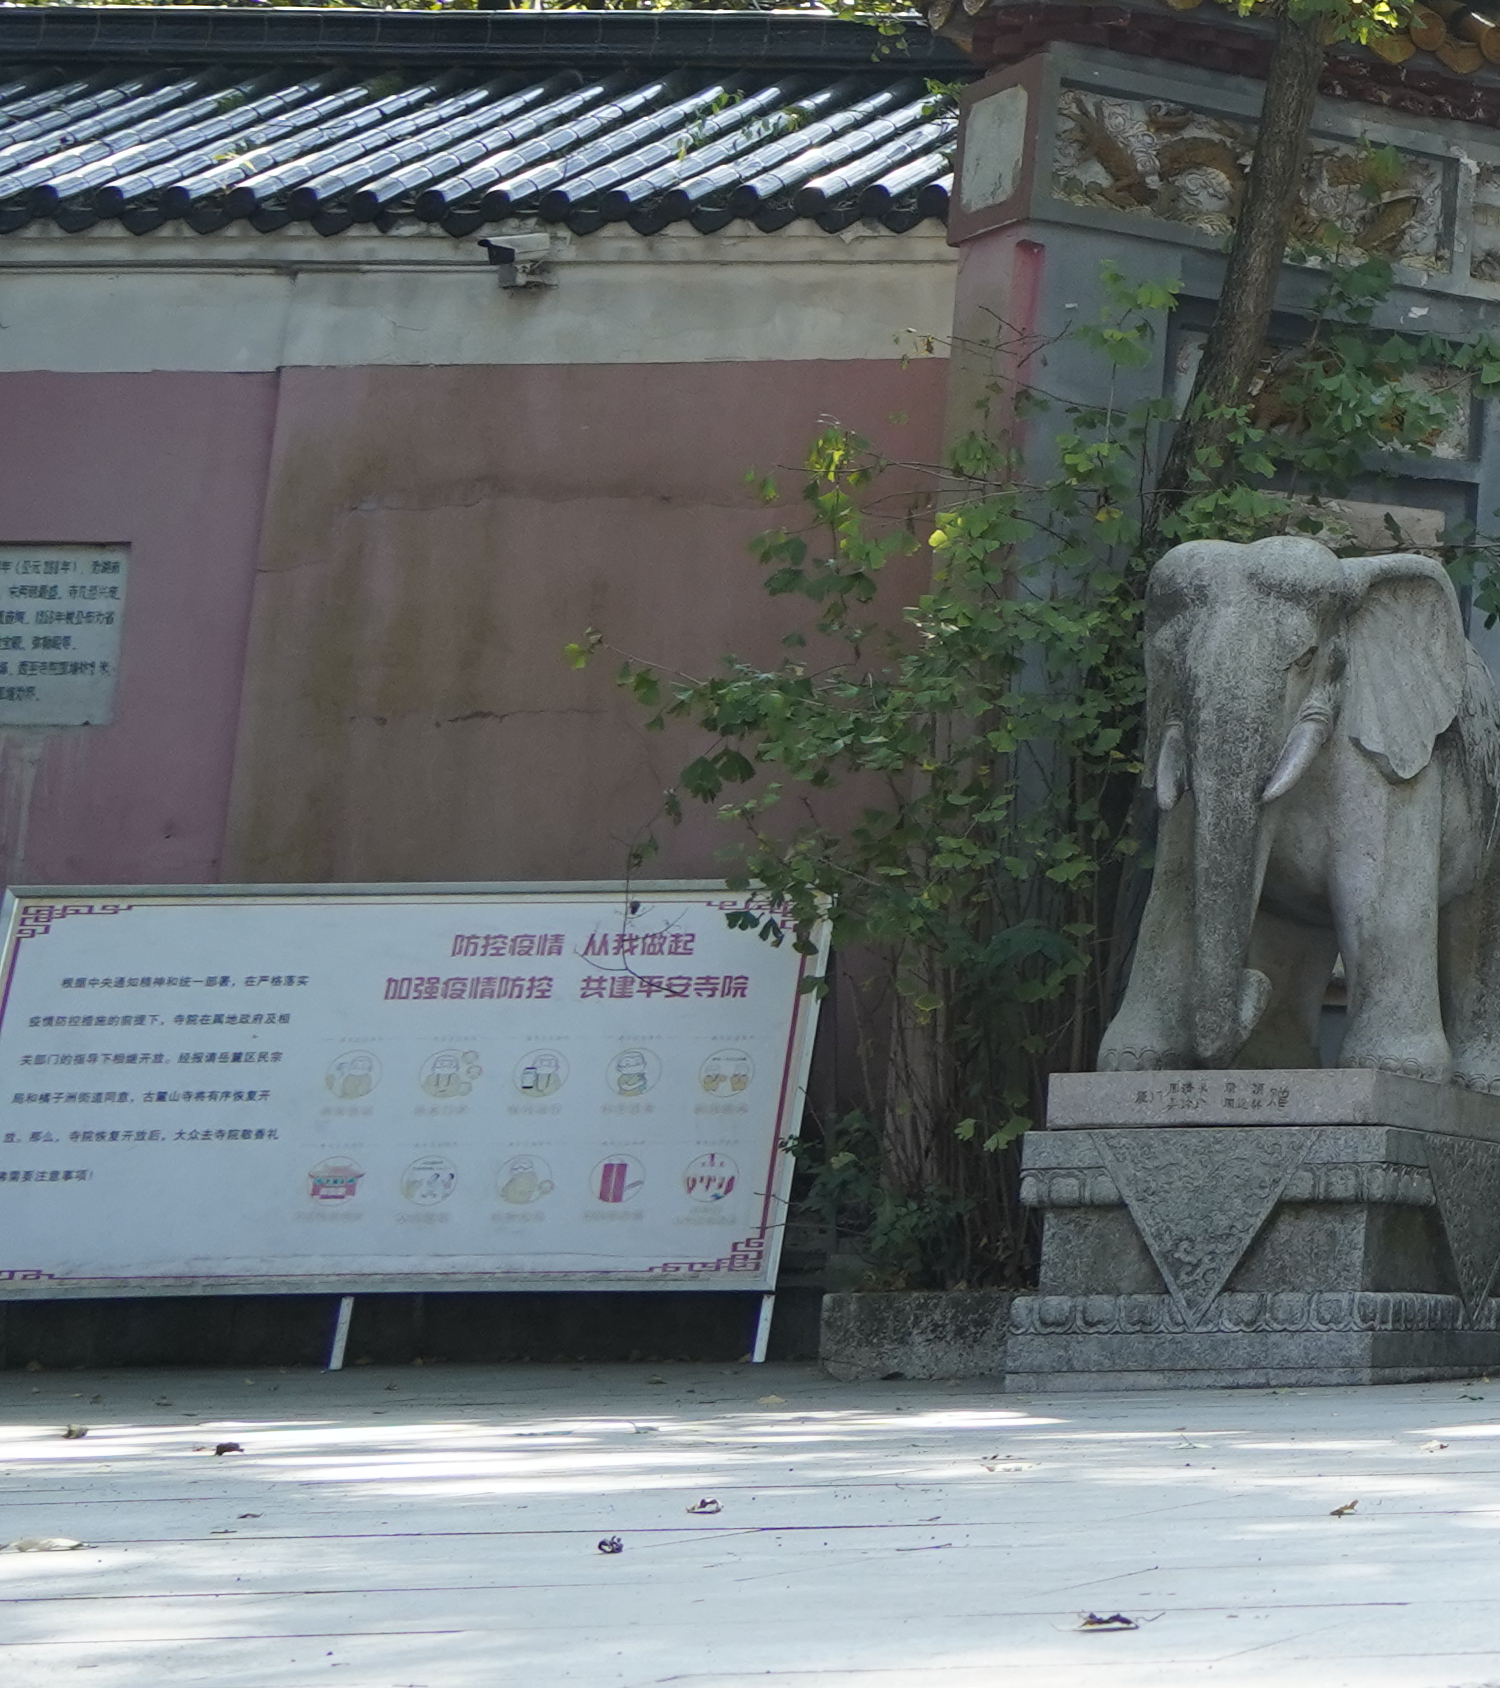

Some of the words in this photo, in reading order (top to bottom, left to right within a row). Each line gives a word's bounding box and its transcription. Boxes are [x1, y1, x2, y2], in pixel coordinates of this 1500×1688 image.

[451, 934, 565, 957] 防控疫情
[583, 932, 696, 956] 从我做起
[384, 976, 553, 1000] 加强疫情防控
[580, 975, 750, 998] 共建平安寺院
